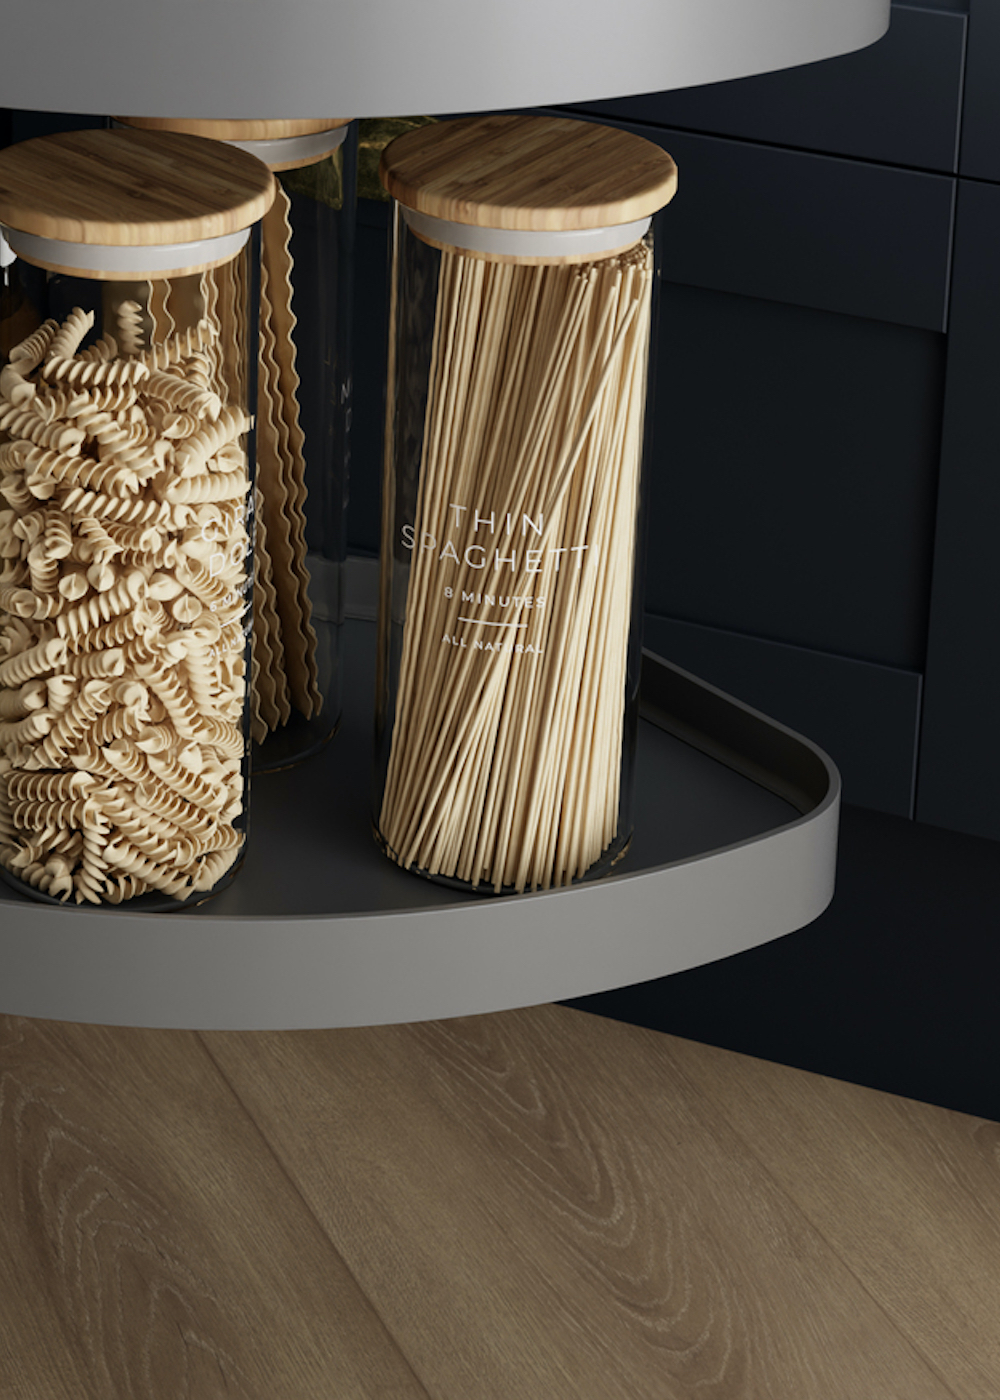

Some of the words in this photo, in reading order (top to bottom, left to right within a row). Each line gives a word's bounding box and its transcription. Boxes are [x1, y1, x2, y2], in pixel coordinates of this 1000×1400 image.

[449, 502, 545, 538] THIN
[400, 523, 600, 574] SPAGHETTI
[461, 589, 547, 610] MINUTES
[441, 632, 467, 649] ALL
[474, 638, 544, 655] NATURAL
